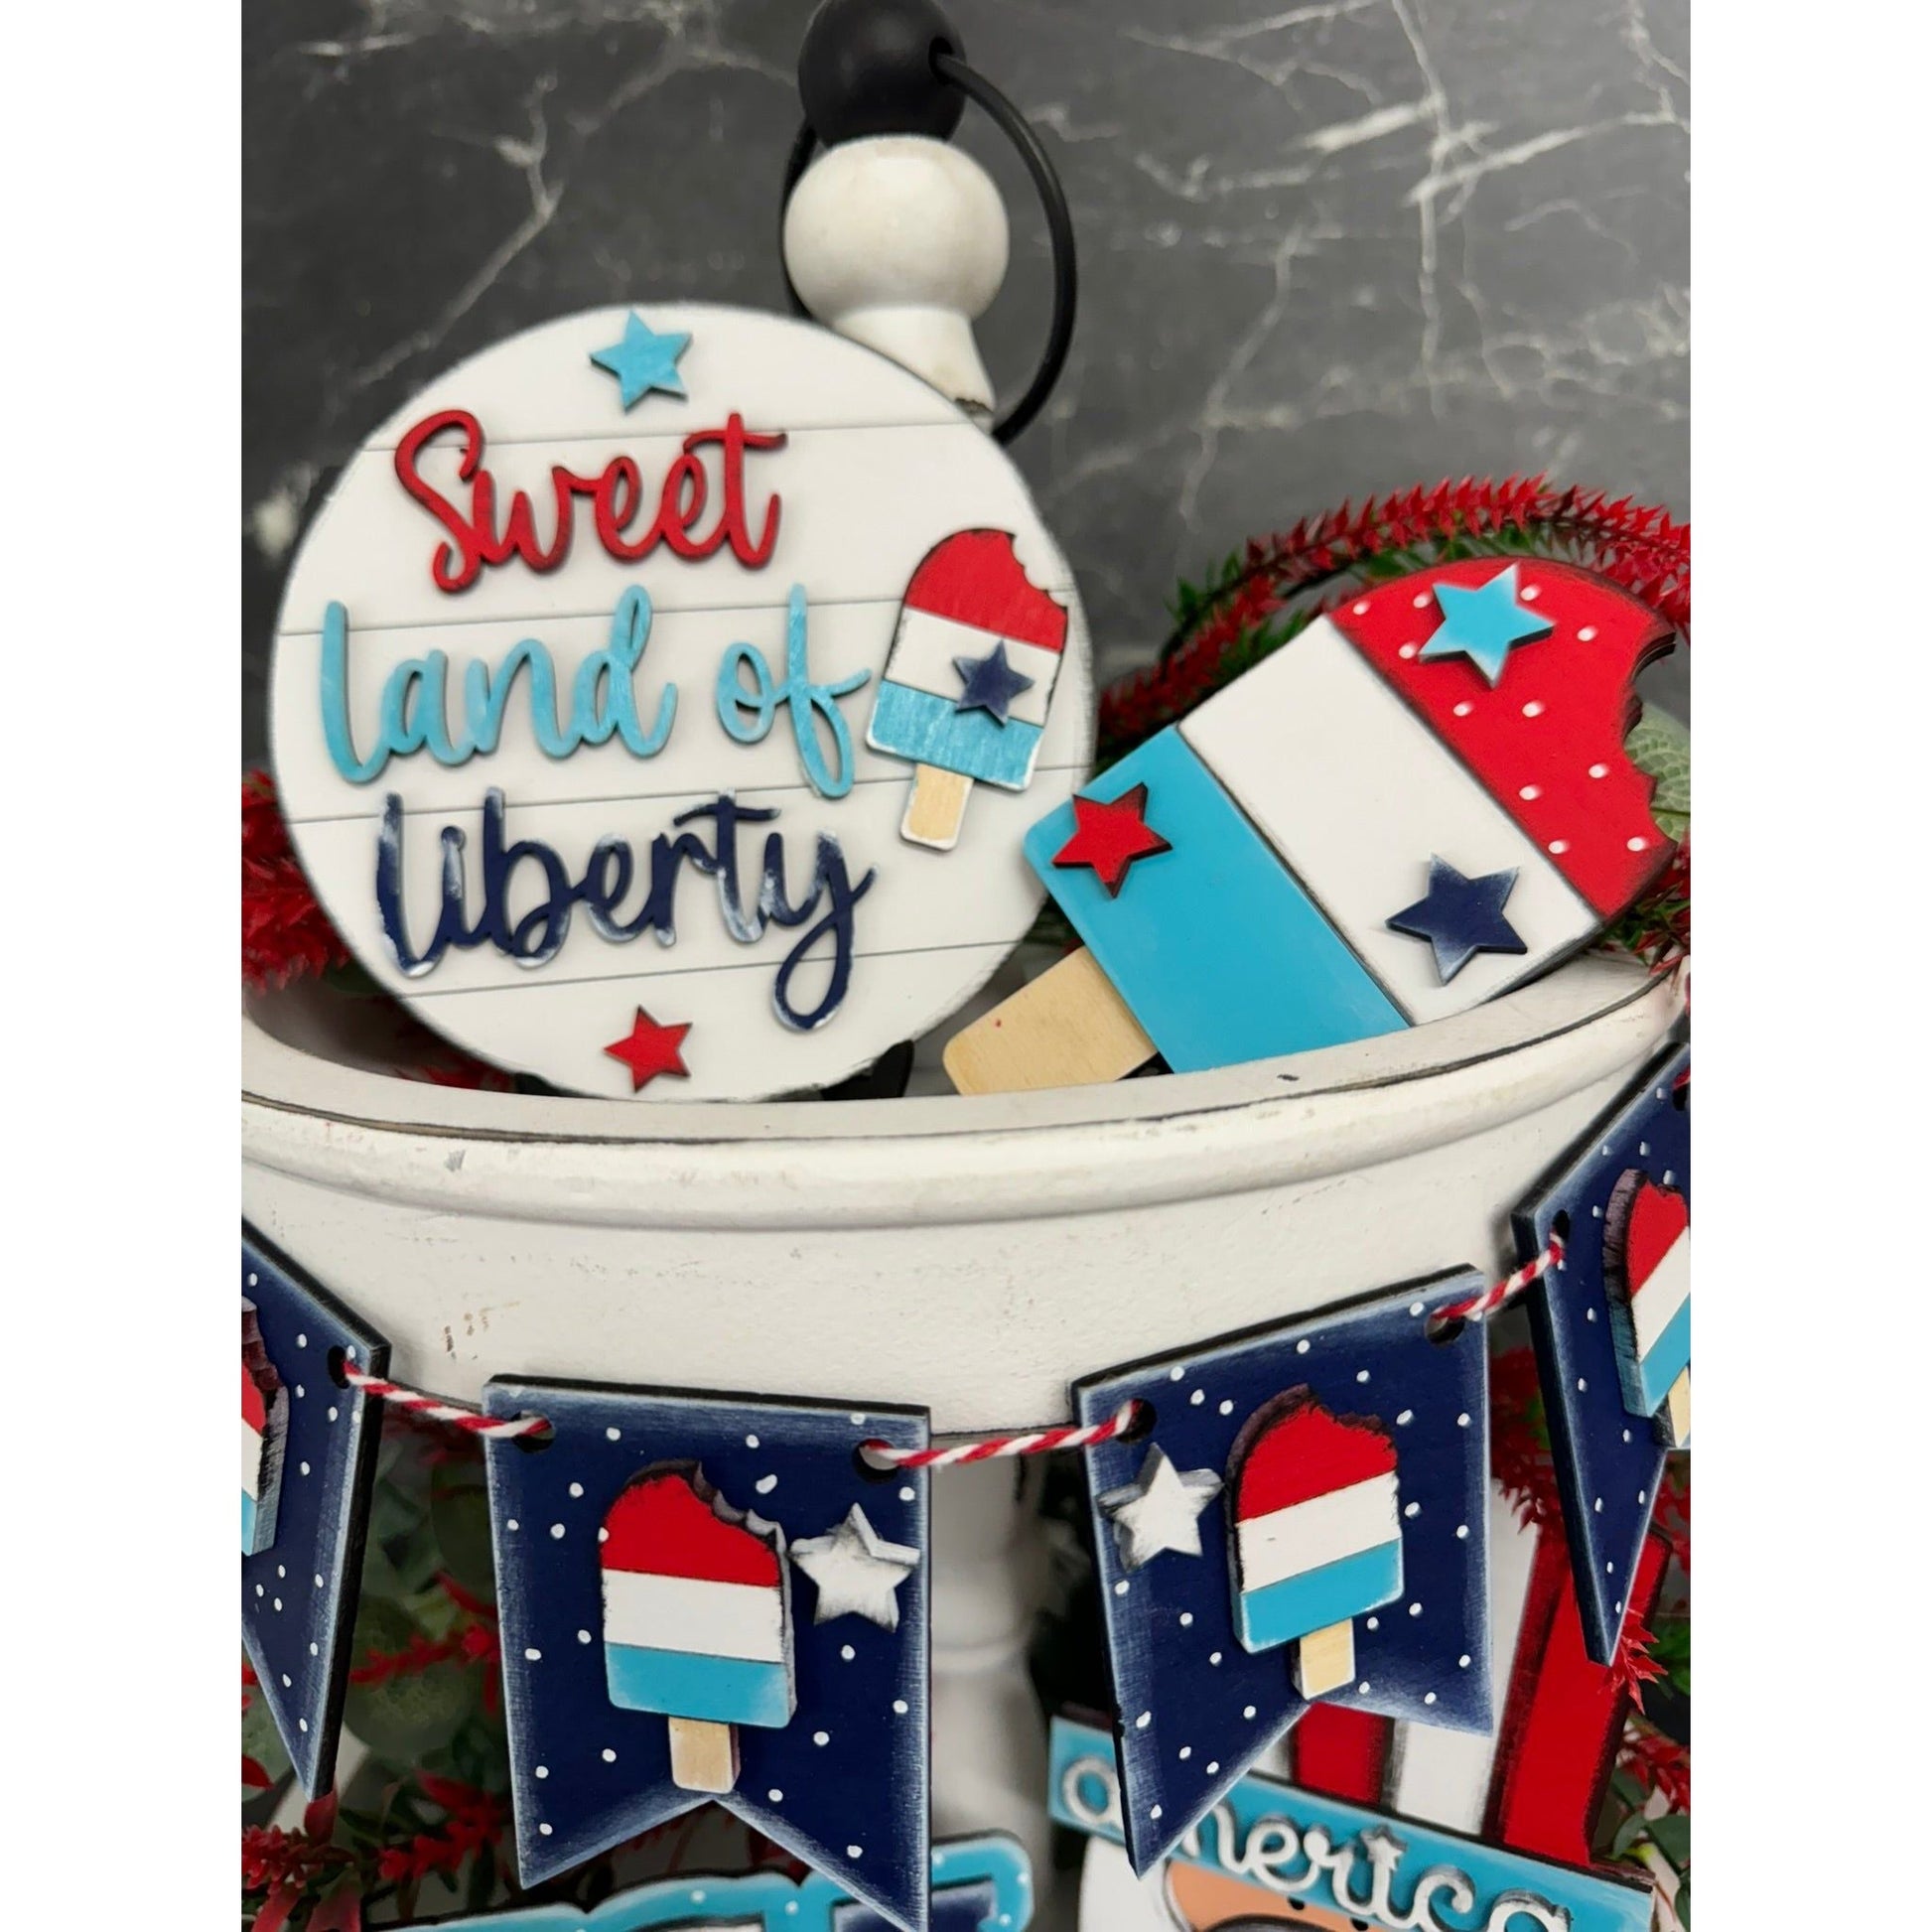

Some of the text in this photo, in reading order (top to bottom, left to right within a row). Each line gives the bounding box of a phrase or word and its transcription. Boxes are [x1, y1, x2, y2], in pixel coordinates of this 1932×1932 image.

[394, 408, 788, 594] Sweet
[320, 583, 872, 799] land of
[375, 786, 879, 1033] liberty
